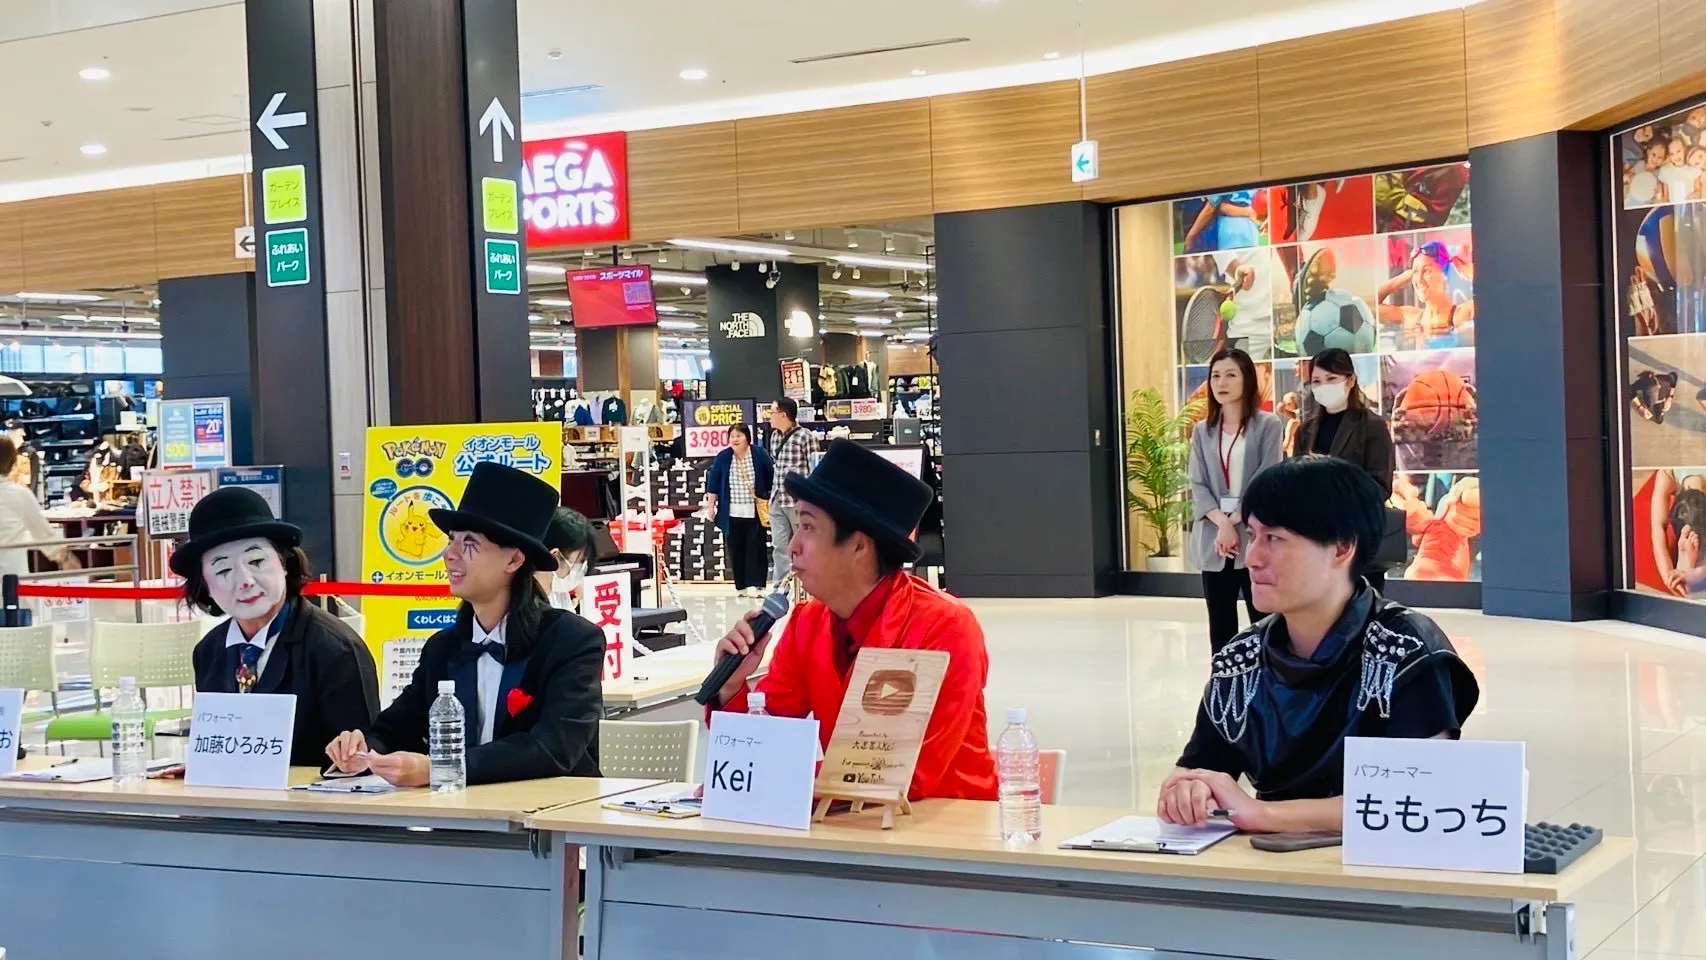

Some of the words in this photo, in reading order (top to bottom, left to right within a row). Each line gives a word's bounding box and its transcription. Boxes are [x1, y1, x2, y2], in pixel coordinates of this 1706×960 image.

[269, 181, 299, 192] ガーデン
[270, 197, 300, 210] プレイス
[271, 243, 304, 256] ふれあい
[489, 252, 516, 265] ふれあい
[276, 260, 299, 272] パーク
[493, 269, 513, 281] パーク
[732, 312, 749, 321] THE
[720, 320, 749, 331] NORTH
[728, 329, 749, 338] FACE
[710, 404, 743, 413] SPECIAL
[710, 412, 743, 425] PRICE
[464, 435, 539, 451] イオンモール
[396, 458, 433, 478] GO
[150, 477, 206, 510] 立入禁止
[594, 581, 624, 680] 受付
[198, 713, 242, 723] パフォーマー
[194, 734, 284, 755] 加藤ひろみち
[715, 734, 762, 747] パフォーマー
[712, 760, 753, 792] Kei
[1354, 764, 1432, 778] パフォーマー
[1355, 793, 1508, 837] ももっち
